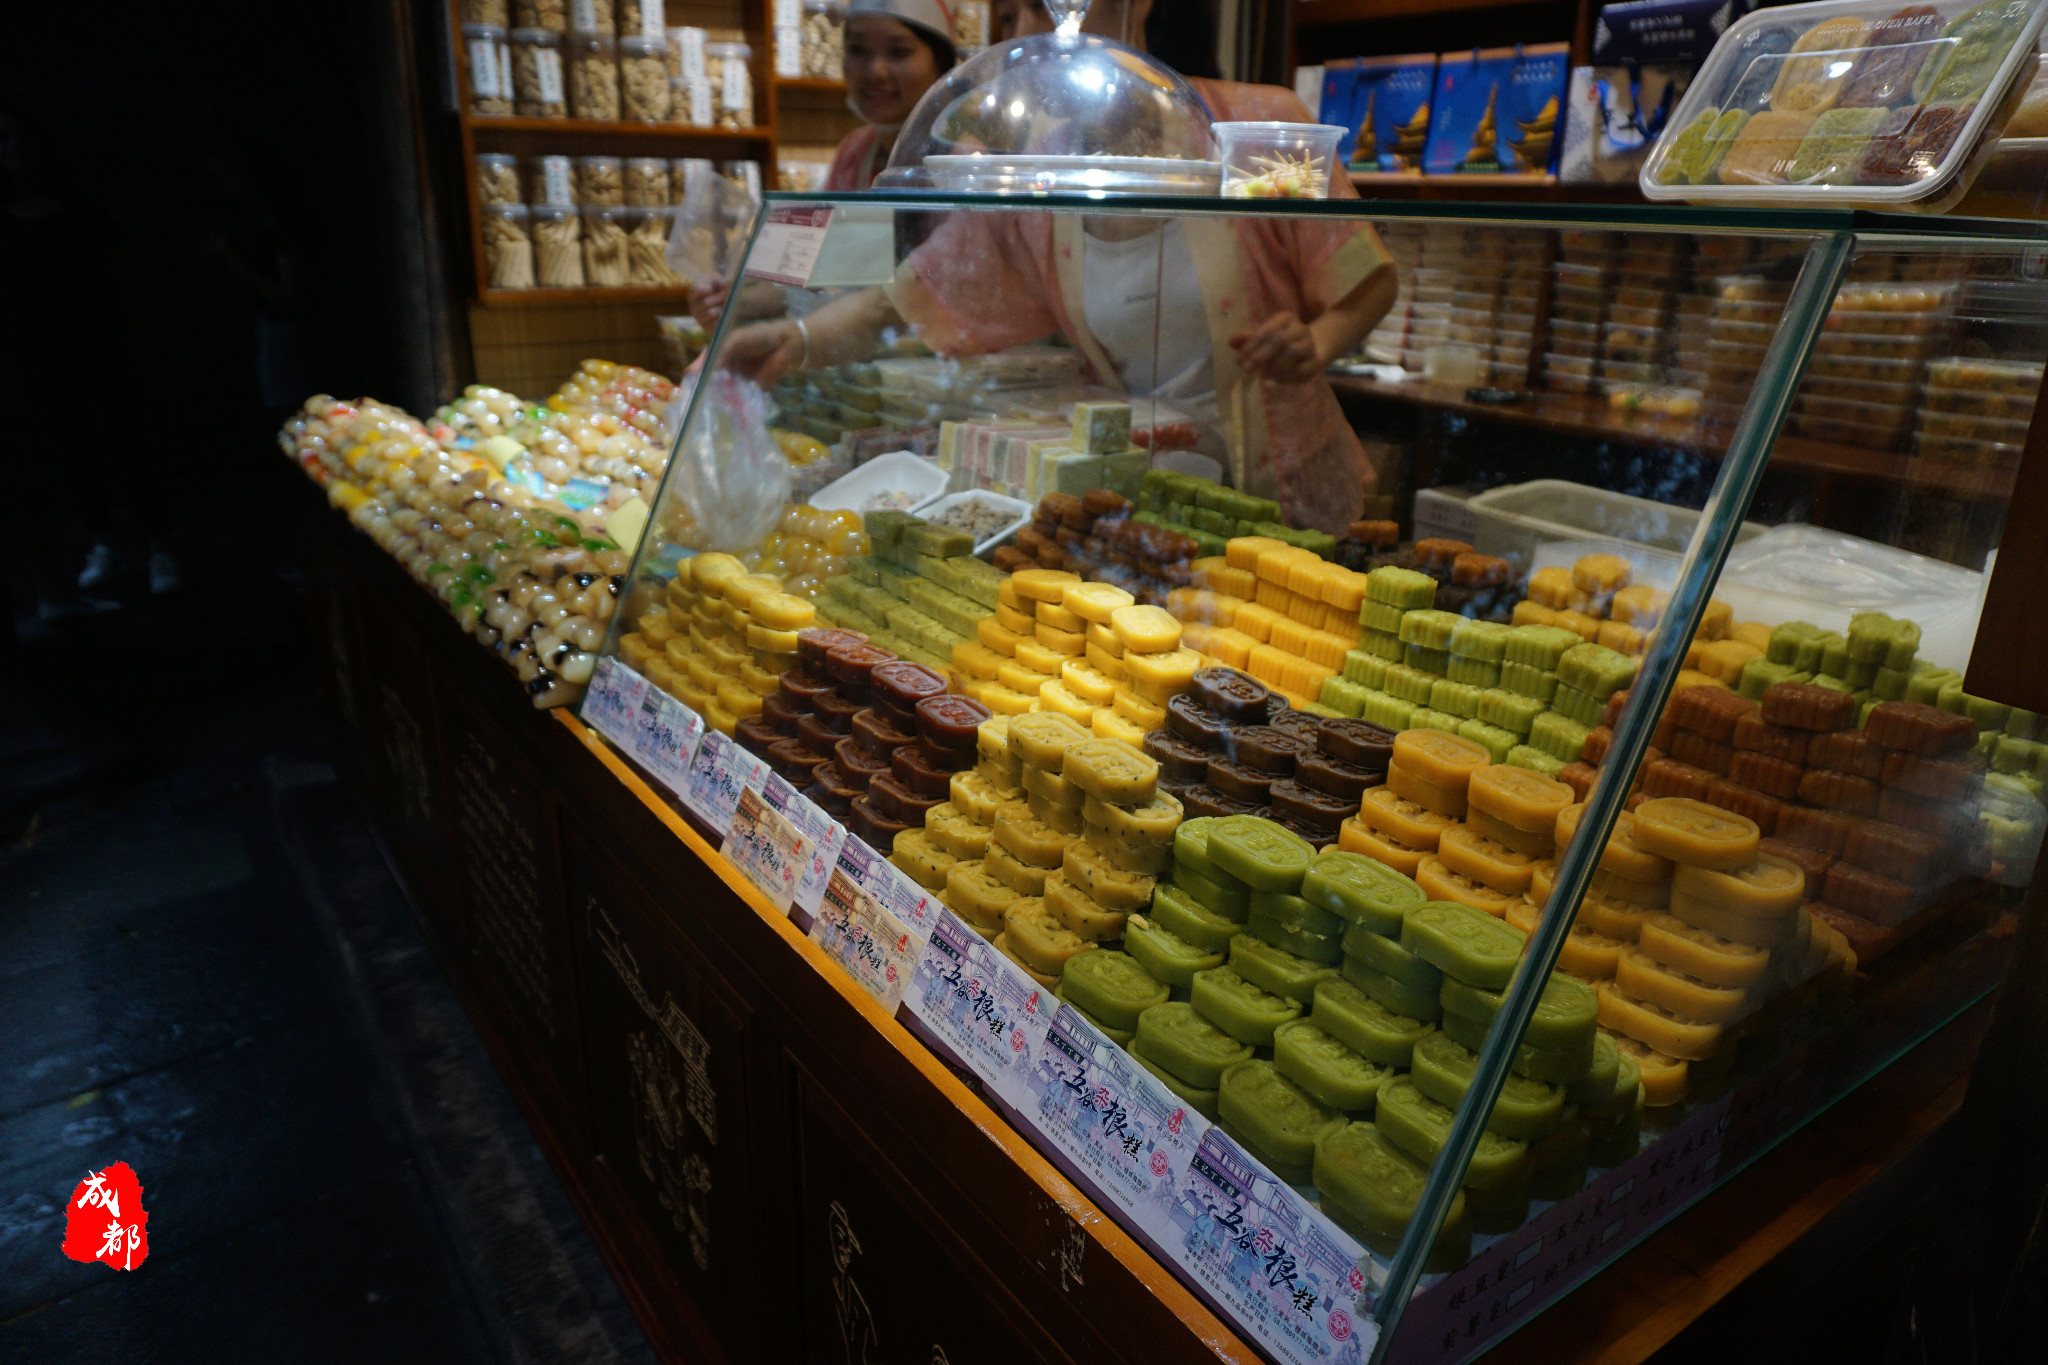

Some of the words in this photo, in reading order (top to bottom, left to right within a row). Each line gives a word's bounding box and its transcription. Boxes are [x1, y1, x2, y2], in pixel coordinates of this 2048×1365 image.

[1876, 18, 1902, 31] OVEN
[835, 914, 882, 975] 五谷杂粮糕
[943, 962, 1006, 1042] 五谷杂粮糕
[1063, 1066, 1144, 1163] 五谷杂粮糕
[1213, 1202, 1319, 1322] 五谷杂粮糕
